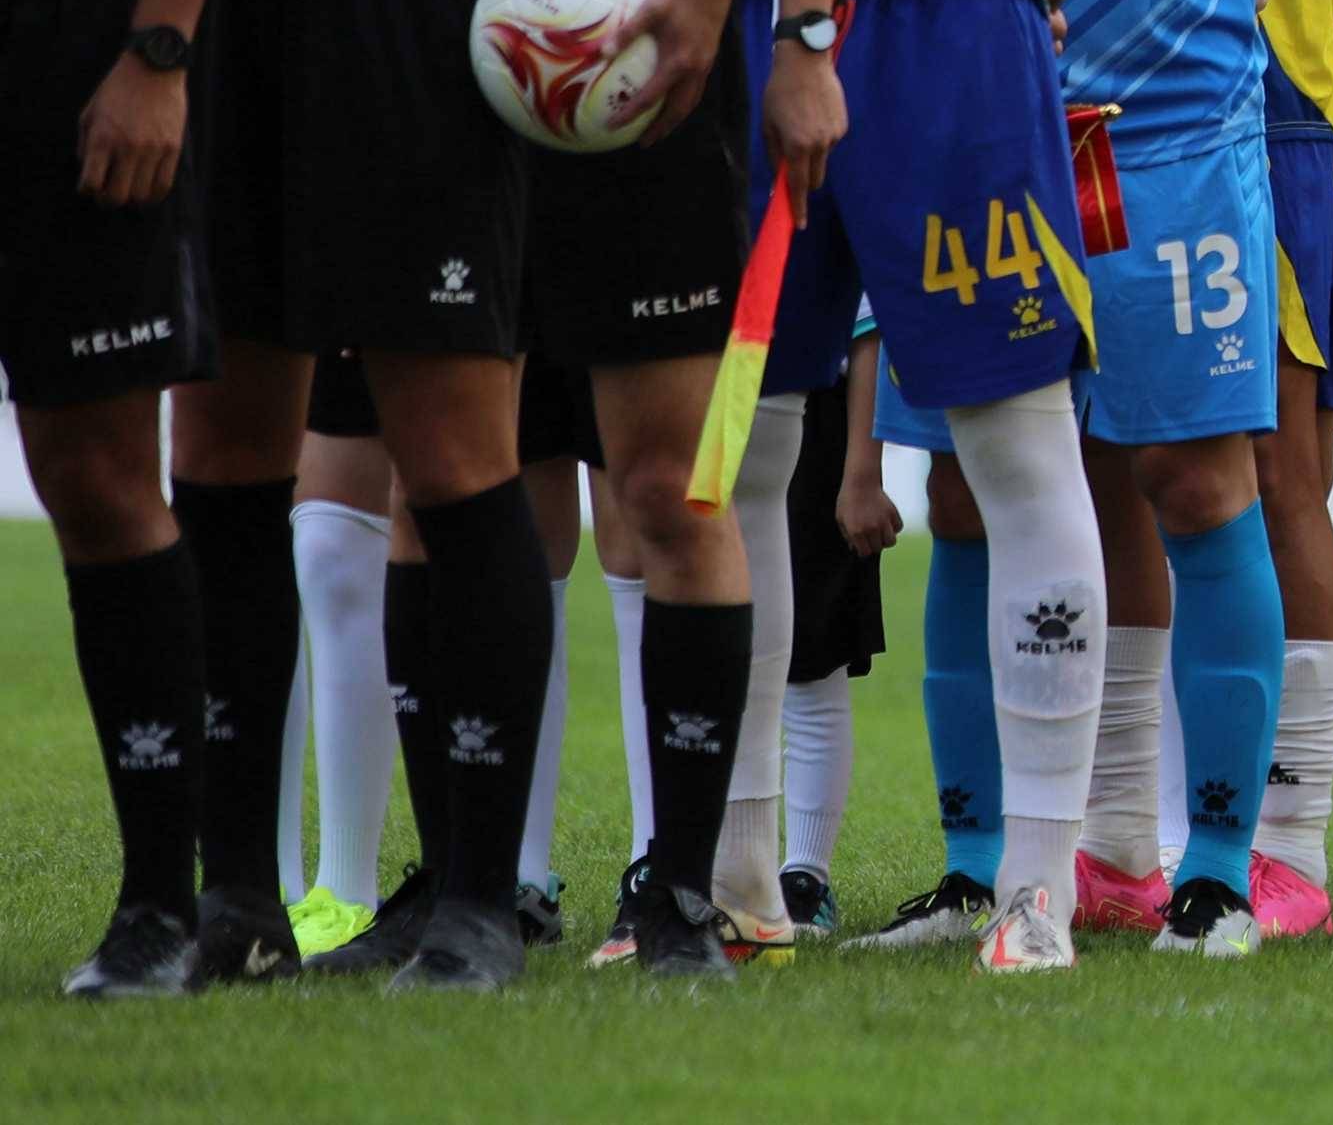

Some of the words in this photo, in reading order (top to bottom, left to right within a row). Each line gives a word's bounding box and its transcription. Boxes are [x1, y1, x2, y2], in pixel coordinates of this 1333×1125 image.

[923, 199, 1043, 305] 44
[429, 290, 475, 304] KELME
[1157, 233, 1248, 335] 13
[632, 287, 721, 317] KELME
[71, 318, 173, 357] KELME
[1008, 319, 1057, 341] KELME
[1209, 359, 1256, 377] KELME
[1016, 639, 1088, 655] KELME
